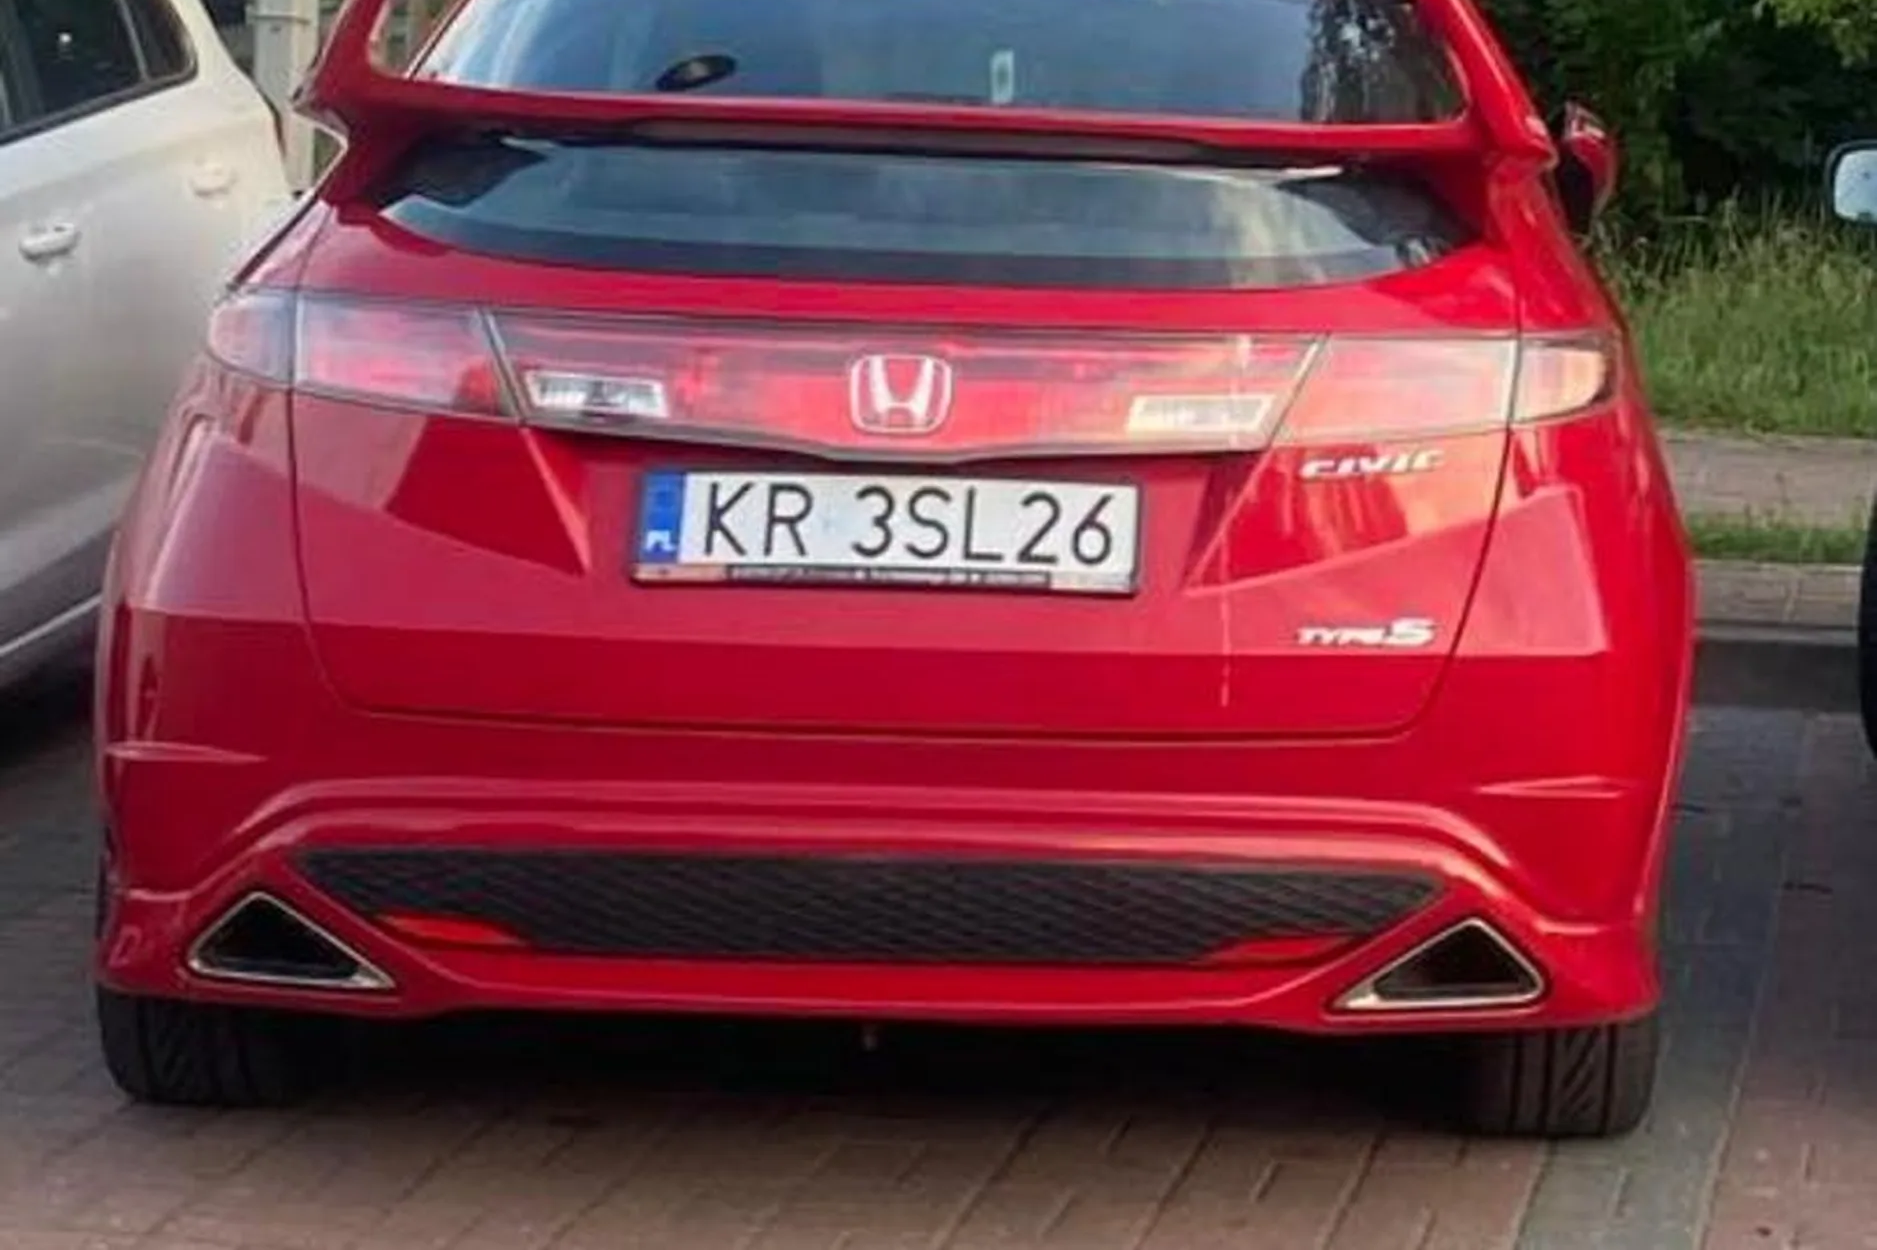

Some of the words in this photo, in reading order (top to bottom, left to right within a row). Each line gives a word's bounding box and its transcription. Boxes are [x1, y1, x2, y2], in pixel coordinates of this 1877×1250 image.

[1299, 450, 1446, 480] CIVIC
[703, 481, 813, 556] KR
[851, 486, 1116, 566] 3SL26
